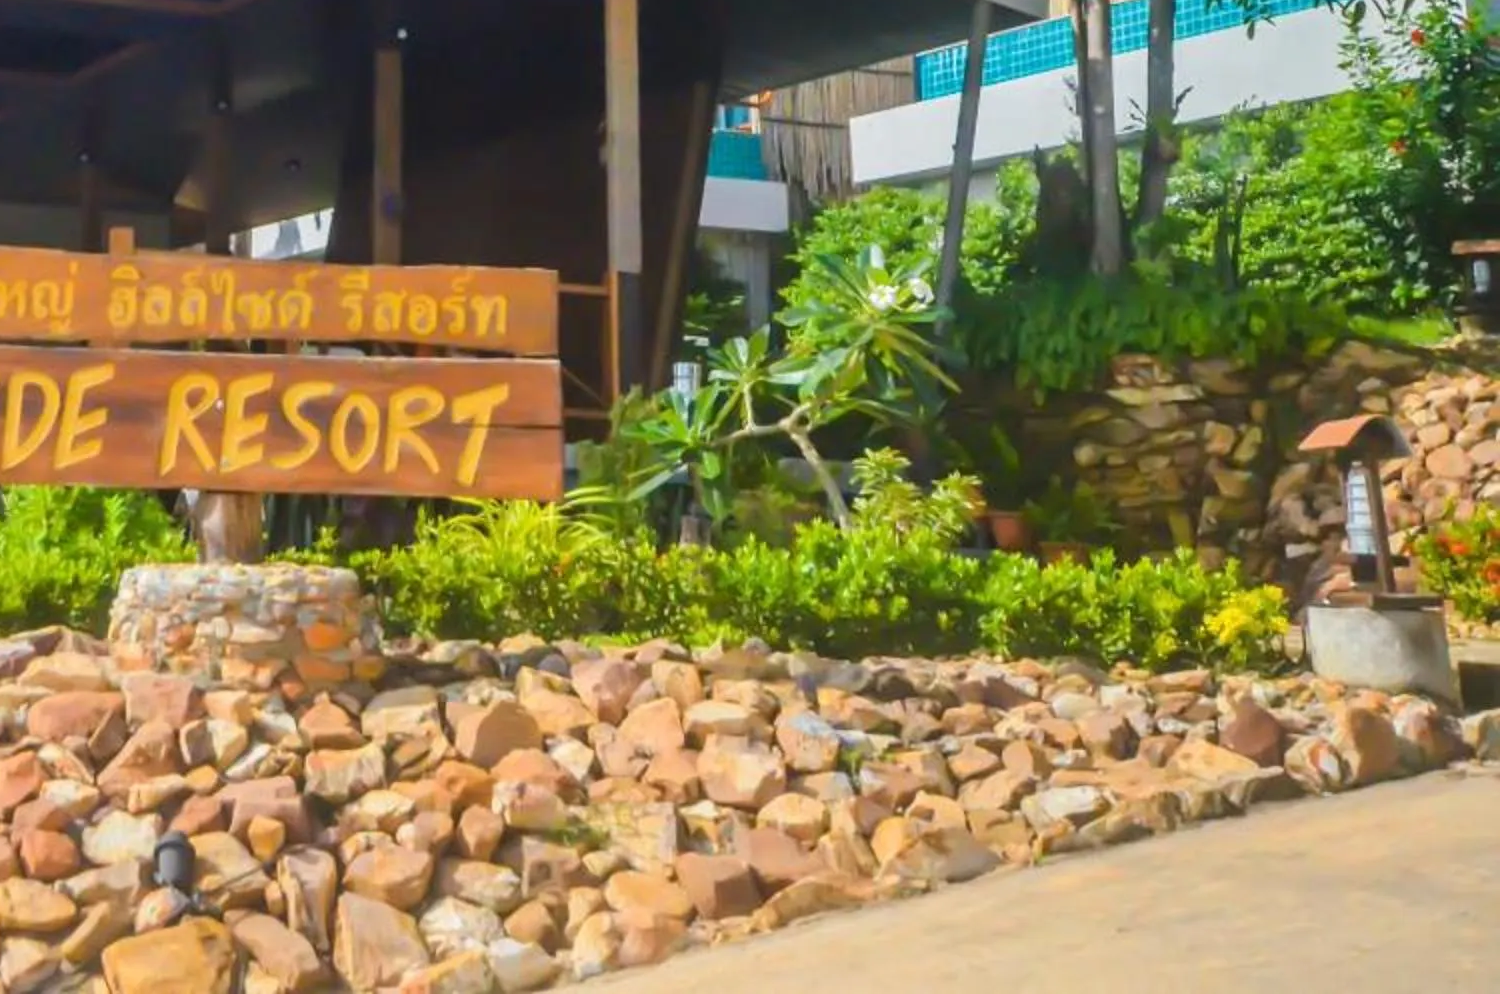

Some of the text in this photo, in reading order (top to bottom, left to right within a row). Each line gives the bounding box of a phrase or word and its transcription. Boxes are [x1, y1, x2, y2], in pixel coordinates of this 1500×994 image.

[107, 263, 319, 334] ฮิลล์ไซด์
[338, 269, 508, 336] รีสอร์ท
[159, 370, 510, 487] RESORT
